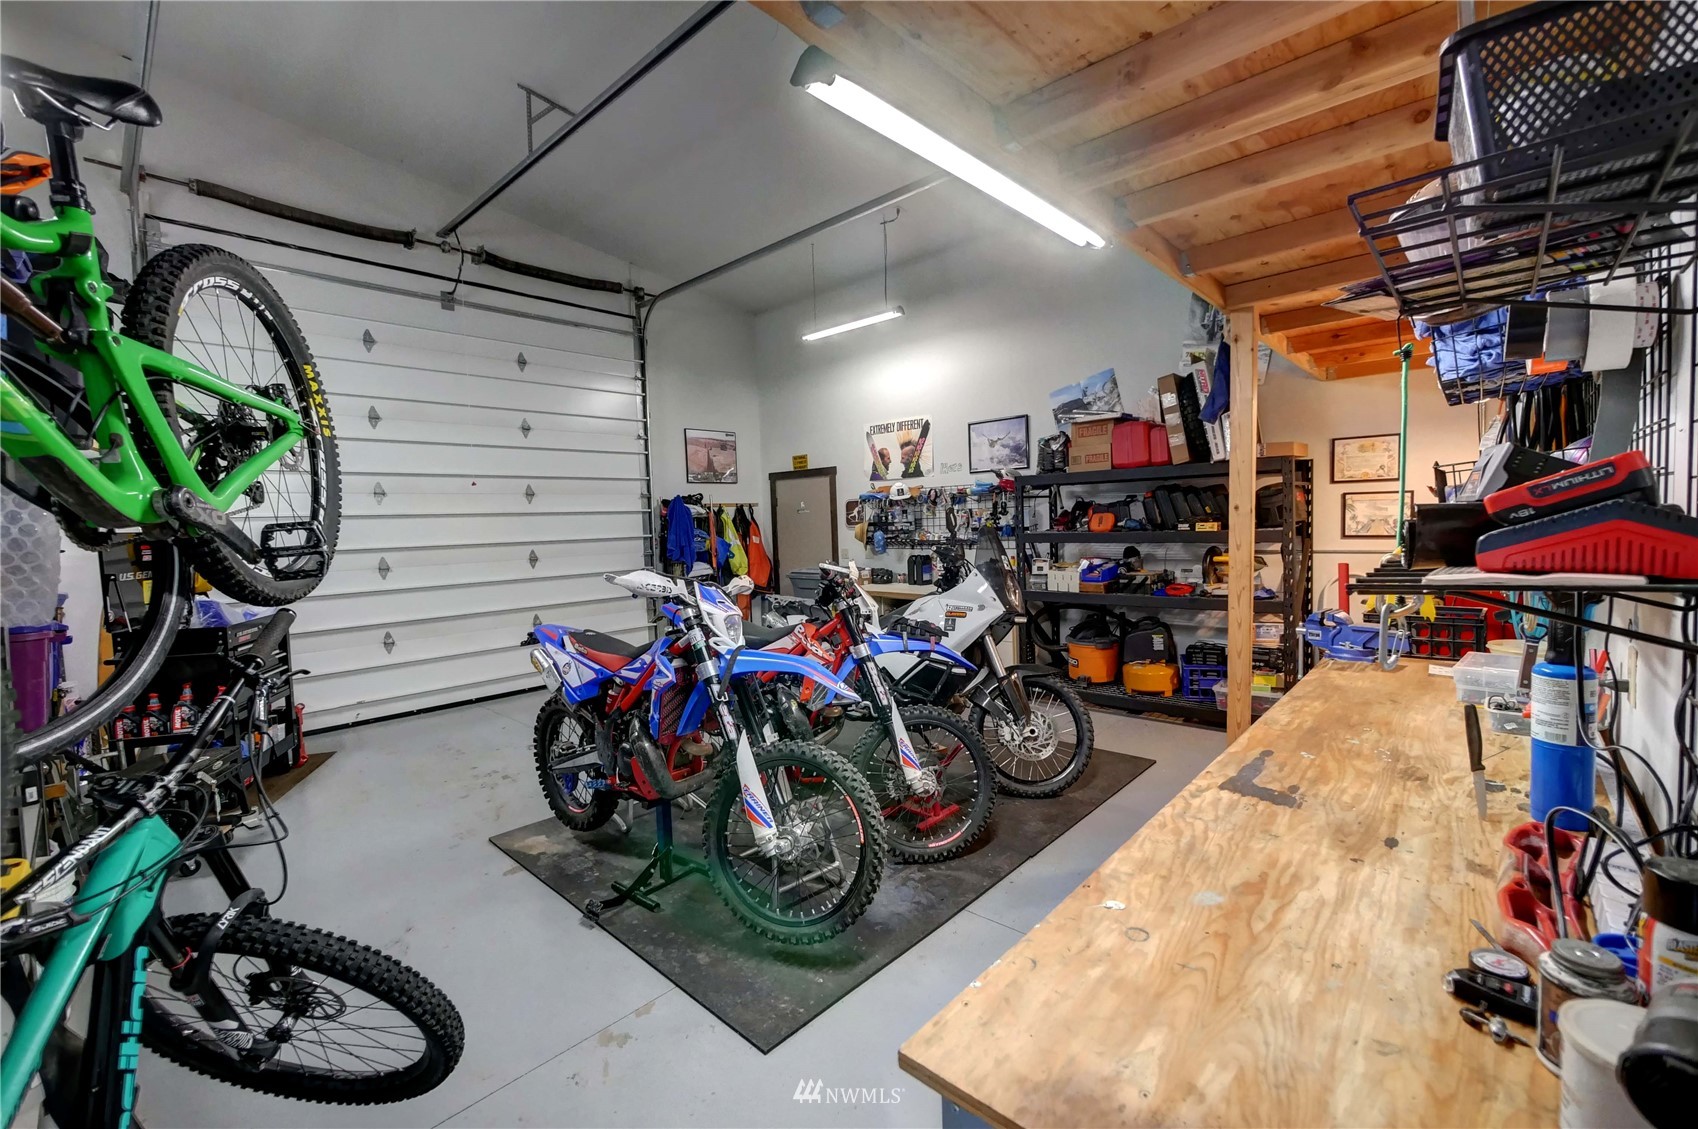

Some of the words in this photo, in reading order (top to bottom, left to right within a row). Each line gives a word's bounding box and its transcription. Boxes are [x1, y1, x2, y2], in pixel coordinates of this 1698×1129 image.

[303, 364, 332, 438] MAXXIS
[869, 422, 896, 436] EXTREMELY
[896, 418, 924, 432] DIFFERENT
[1079, 424, 1108, 437] FRAGILE
[1085, 453, 1109, 463] FRAGILE
[1509, 507, 1536, 519] 18V
[174, 708, 182, 728] MOTUL
[217, 907, 240, 930] LYRIK
